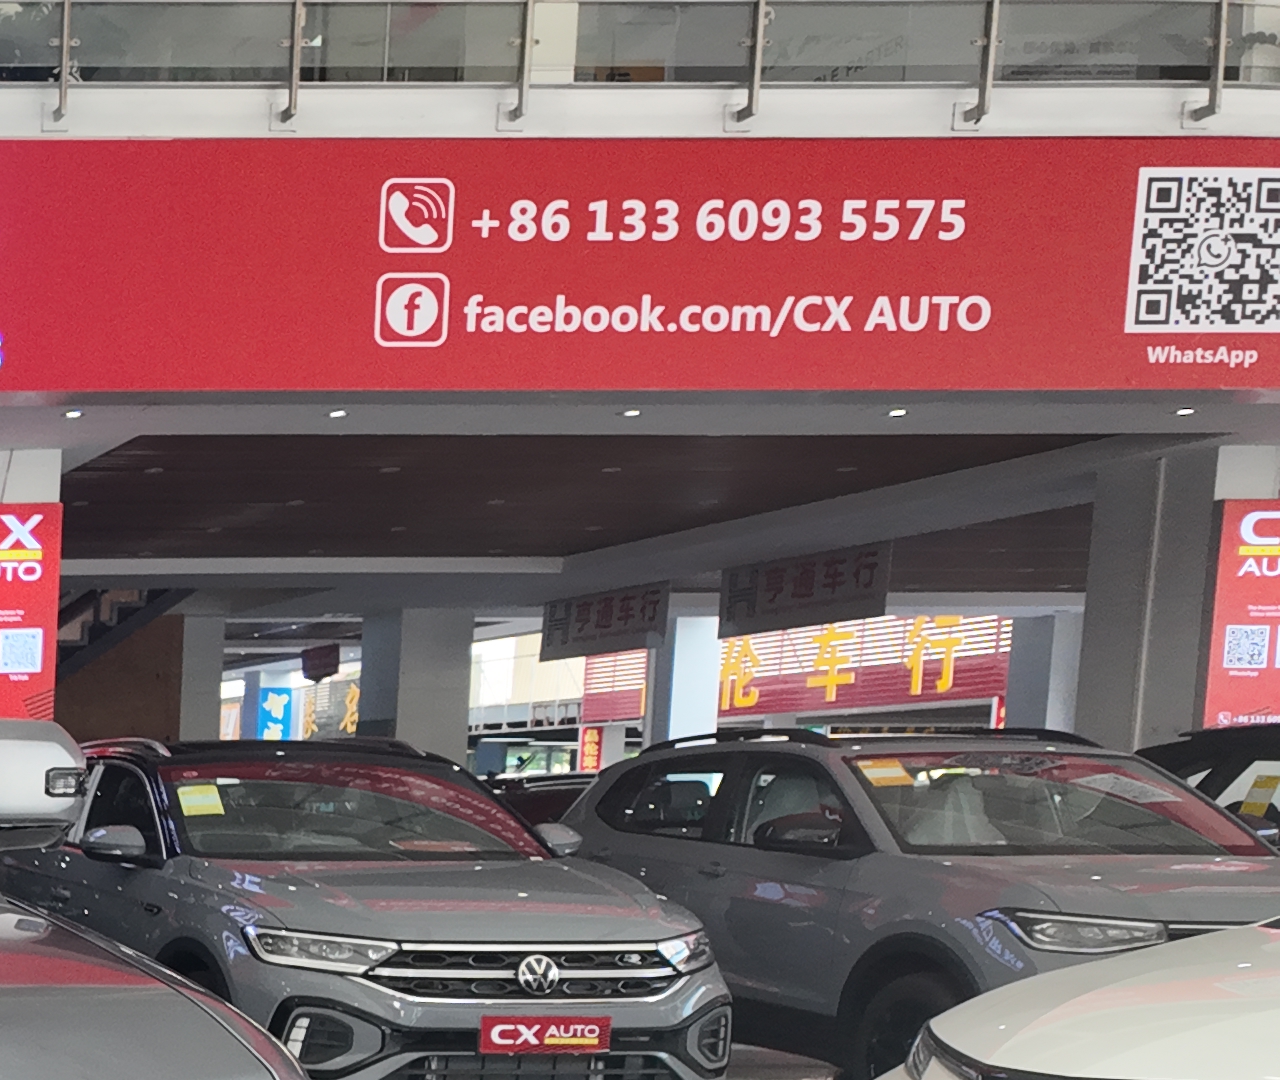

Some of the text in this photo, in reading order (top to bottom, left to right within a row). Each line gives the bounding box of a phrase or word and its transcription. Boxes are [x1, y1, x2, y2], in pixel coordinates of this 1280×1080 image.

[471, 199, 966, 242] +86 133 6093 5575
[463, 294, 992, 337] facebook.com/CX AUTO
[1146, 345, 1259, 368] WhatsApp
[490, 1024, 541, 1045] CX
[545, 1024, 600, 1038] AUTO
